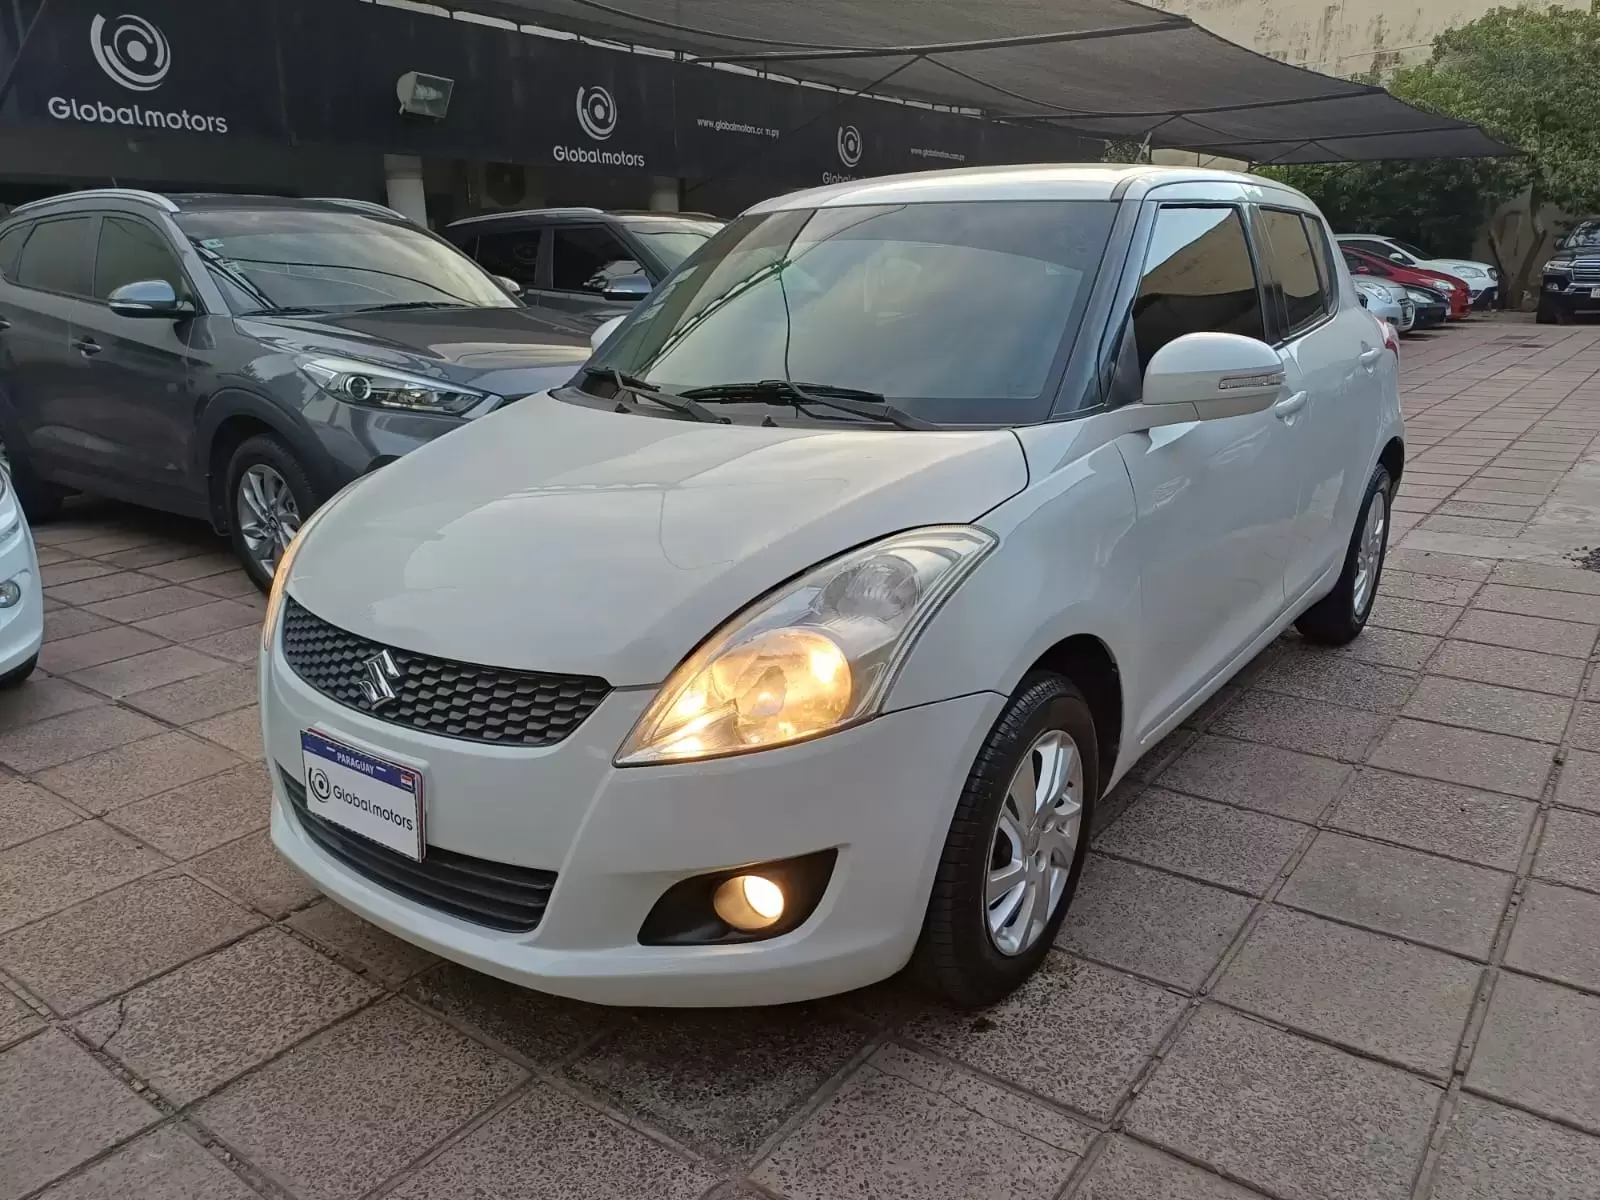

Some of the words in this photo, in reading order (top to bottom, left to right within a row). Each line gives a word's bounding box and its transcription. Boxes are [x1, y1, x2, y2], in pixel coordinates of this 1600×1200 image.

[48, 96, 228, 133] Globalmotors
[553, 145, 645, 167] Globalmotors
[336, 751, 375, 775] PARAGUAY
[332, 784, 414, 832] Globalmotors
